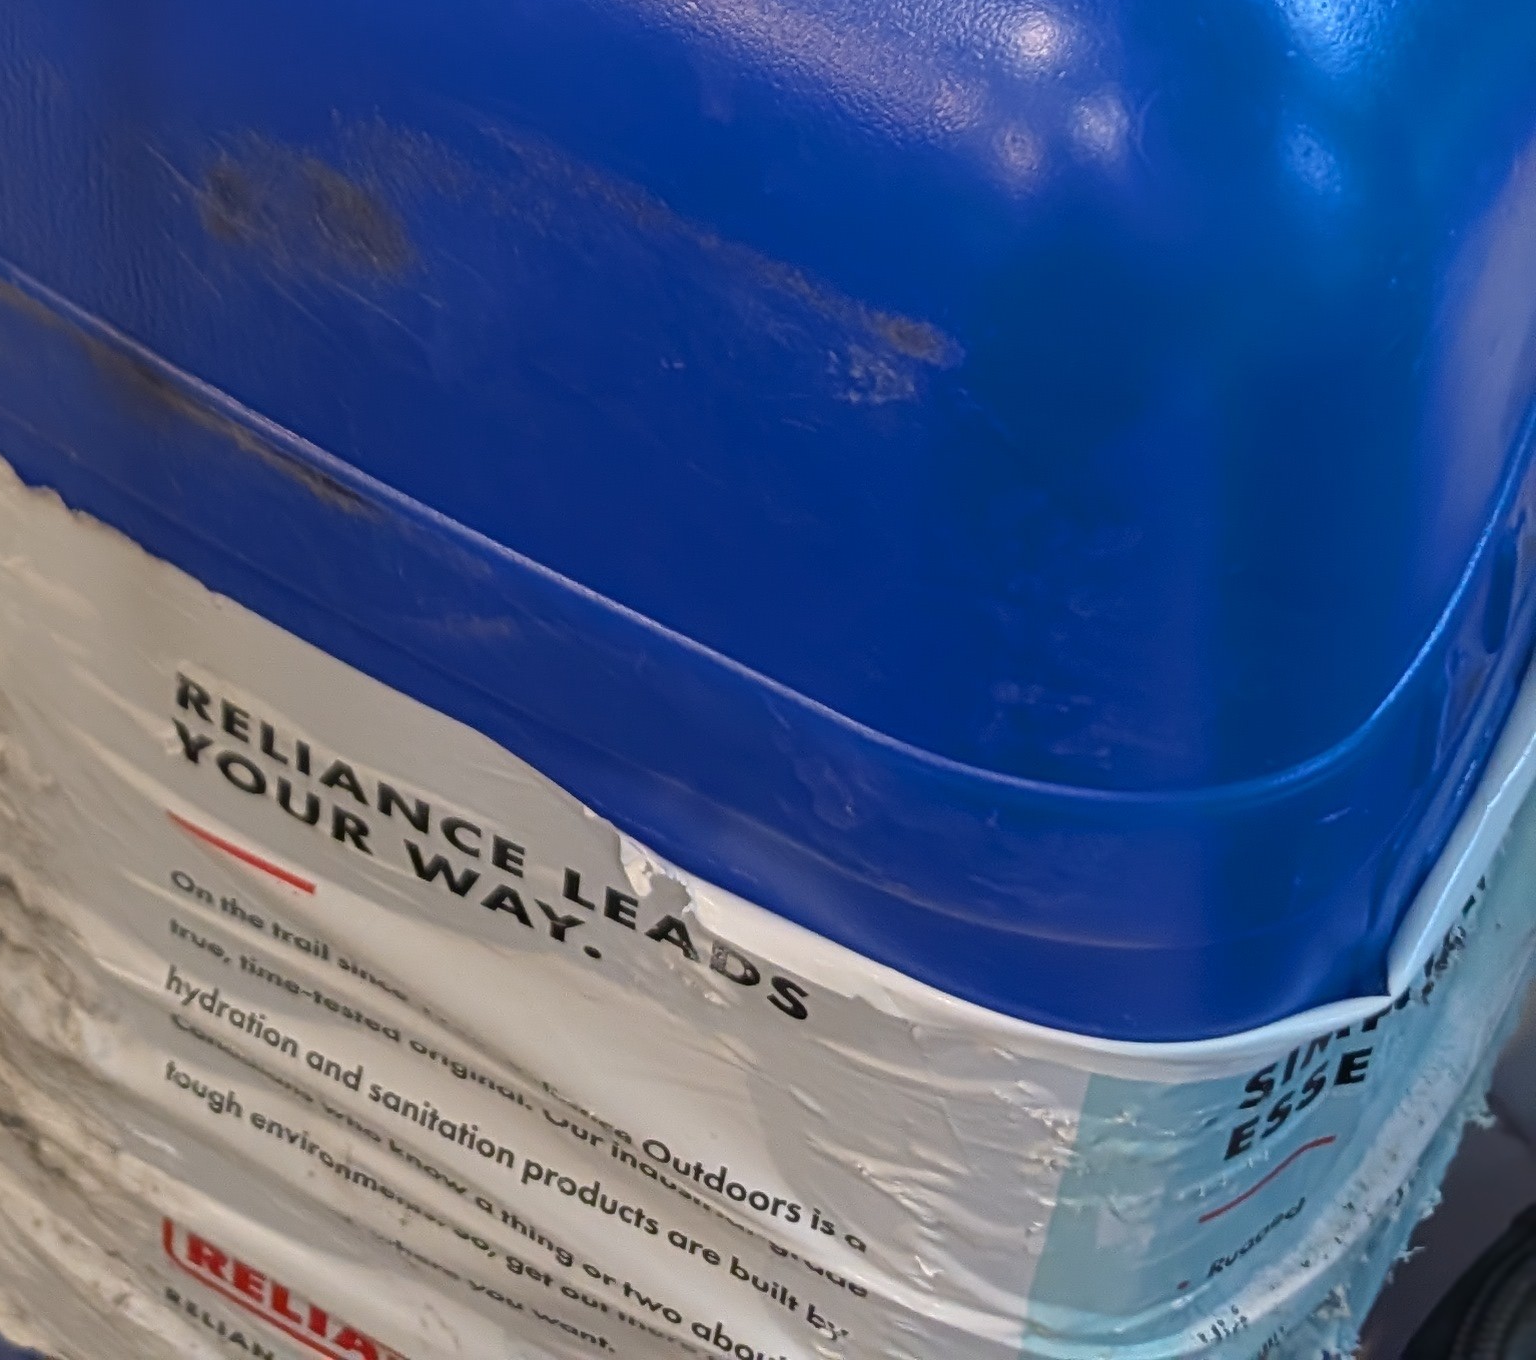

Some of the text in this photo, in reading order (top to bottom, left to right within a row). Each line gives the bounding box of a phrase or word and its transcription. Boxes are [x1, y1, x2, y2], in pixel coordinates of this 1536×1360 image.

[172, 717, 602, 959] YOUR WAY.
[175, 671, 810, 1020] RELIANCE LEADS
[169, 917, 232, 964] true,
[170, 869, 214, 904] On
[219, 895, 264, 929] the
[271, 922, 330, 961] trail
[165, 1058, 244, 1115] tough
[165, 964, 299, 1058] hydration
[305, 1049, 365, 1092] and
[368, 1081, 515, 1169] sanitation
[521, 1157, 661, 1236] products
[667, 1229, 722, 1267] are
[729, 1254, 800, 1313] built
[474, 1194, 494, 1215] a
[500, 1209, 576, 1268] thing
[582, 1262, 618, 1285] or
[623, 1280, 683, 1324] two
[642, 1138, 868, 1253] Outdoors is a
[185, 1231, 402, 1360] RELIA
